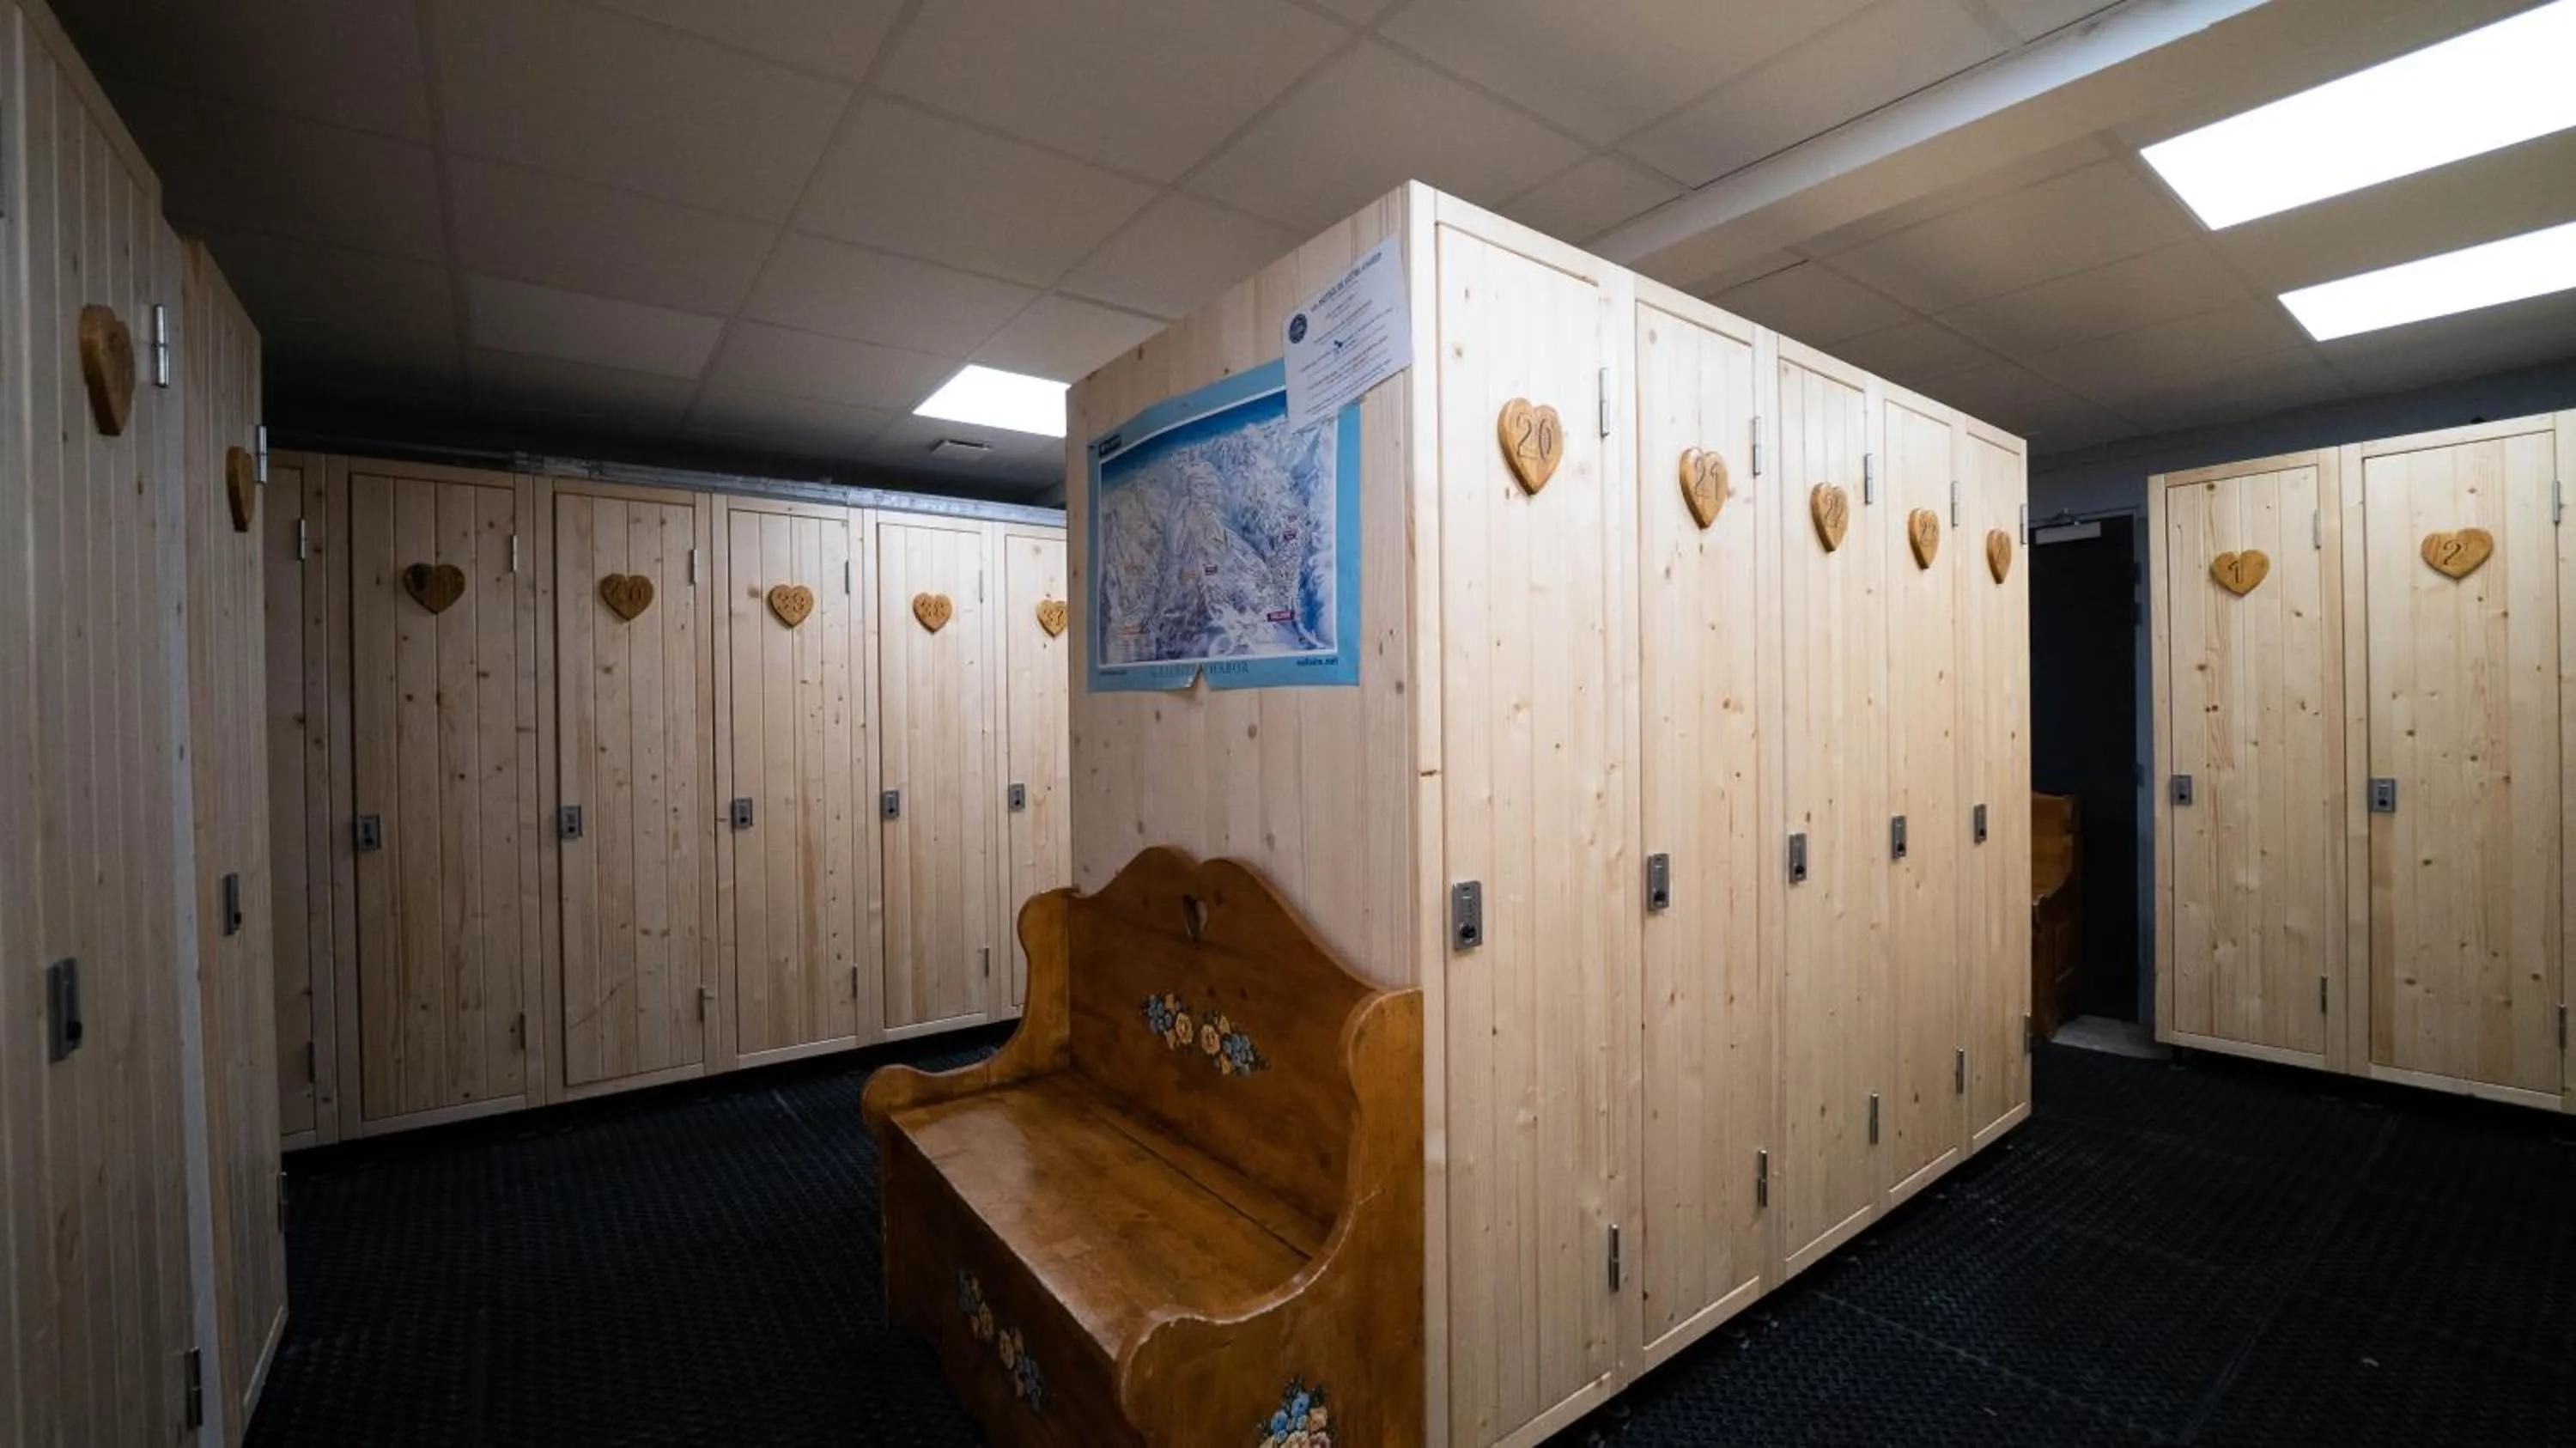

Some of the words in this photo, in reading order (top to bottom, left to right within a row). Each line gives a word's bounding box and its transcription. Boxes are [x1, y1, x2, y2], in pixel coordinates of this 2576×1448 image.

[1516, 411, 1552, 462] 20
[1694, 456, 1719, 501] 21
[2227, 560, 2242, 584] 1
[2442, 539, 2464, 568] 2
